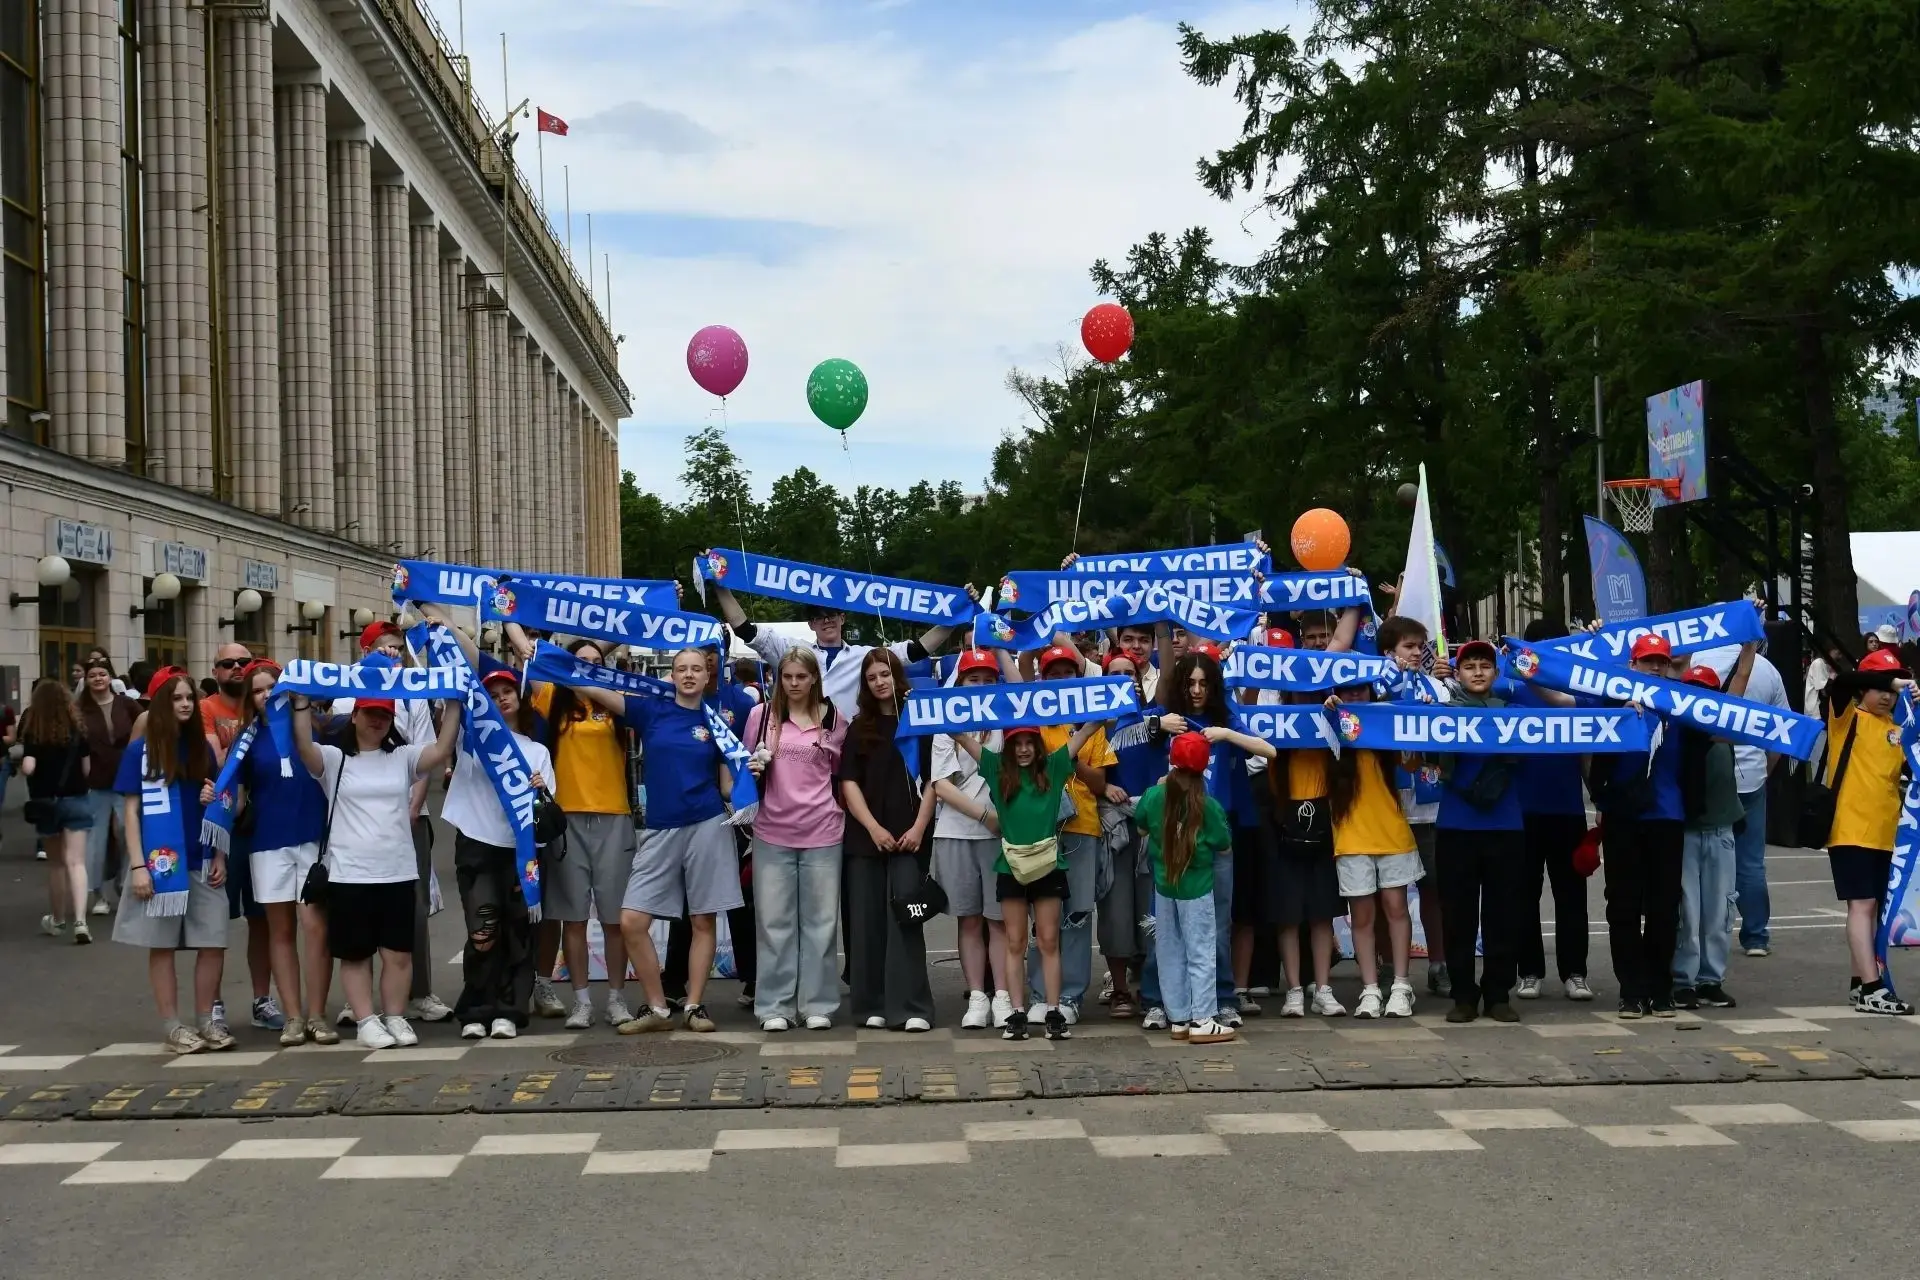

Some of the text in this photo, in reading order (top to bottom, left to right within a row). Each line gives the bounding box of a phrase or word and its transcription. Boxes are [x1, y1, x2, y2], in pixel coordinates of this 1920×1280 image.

[97, 530, 104, 561] 4
[754, 562, 957, 618] ШСК УСПЕХ
[1048, 579, 1129, 603] ШСК
[545, 597, 631, 636] ШСК
[1121, 587, 1235, 634] УСПЕХ
[278, 659, 367, 689] ШСК
[908, 681, 1134, 726] ШСК УСПЕХ
[1568, 664, 1799, 745] ШСК УСПЕХ
[1394, 714, 1622, 744] ШСК УСПЕХ
